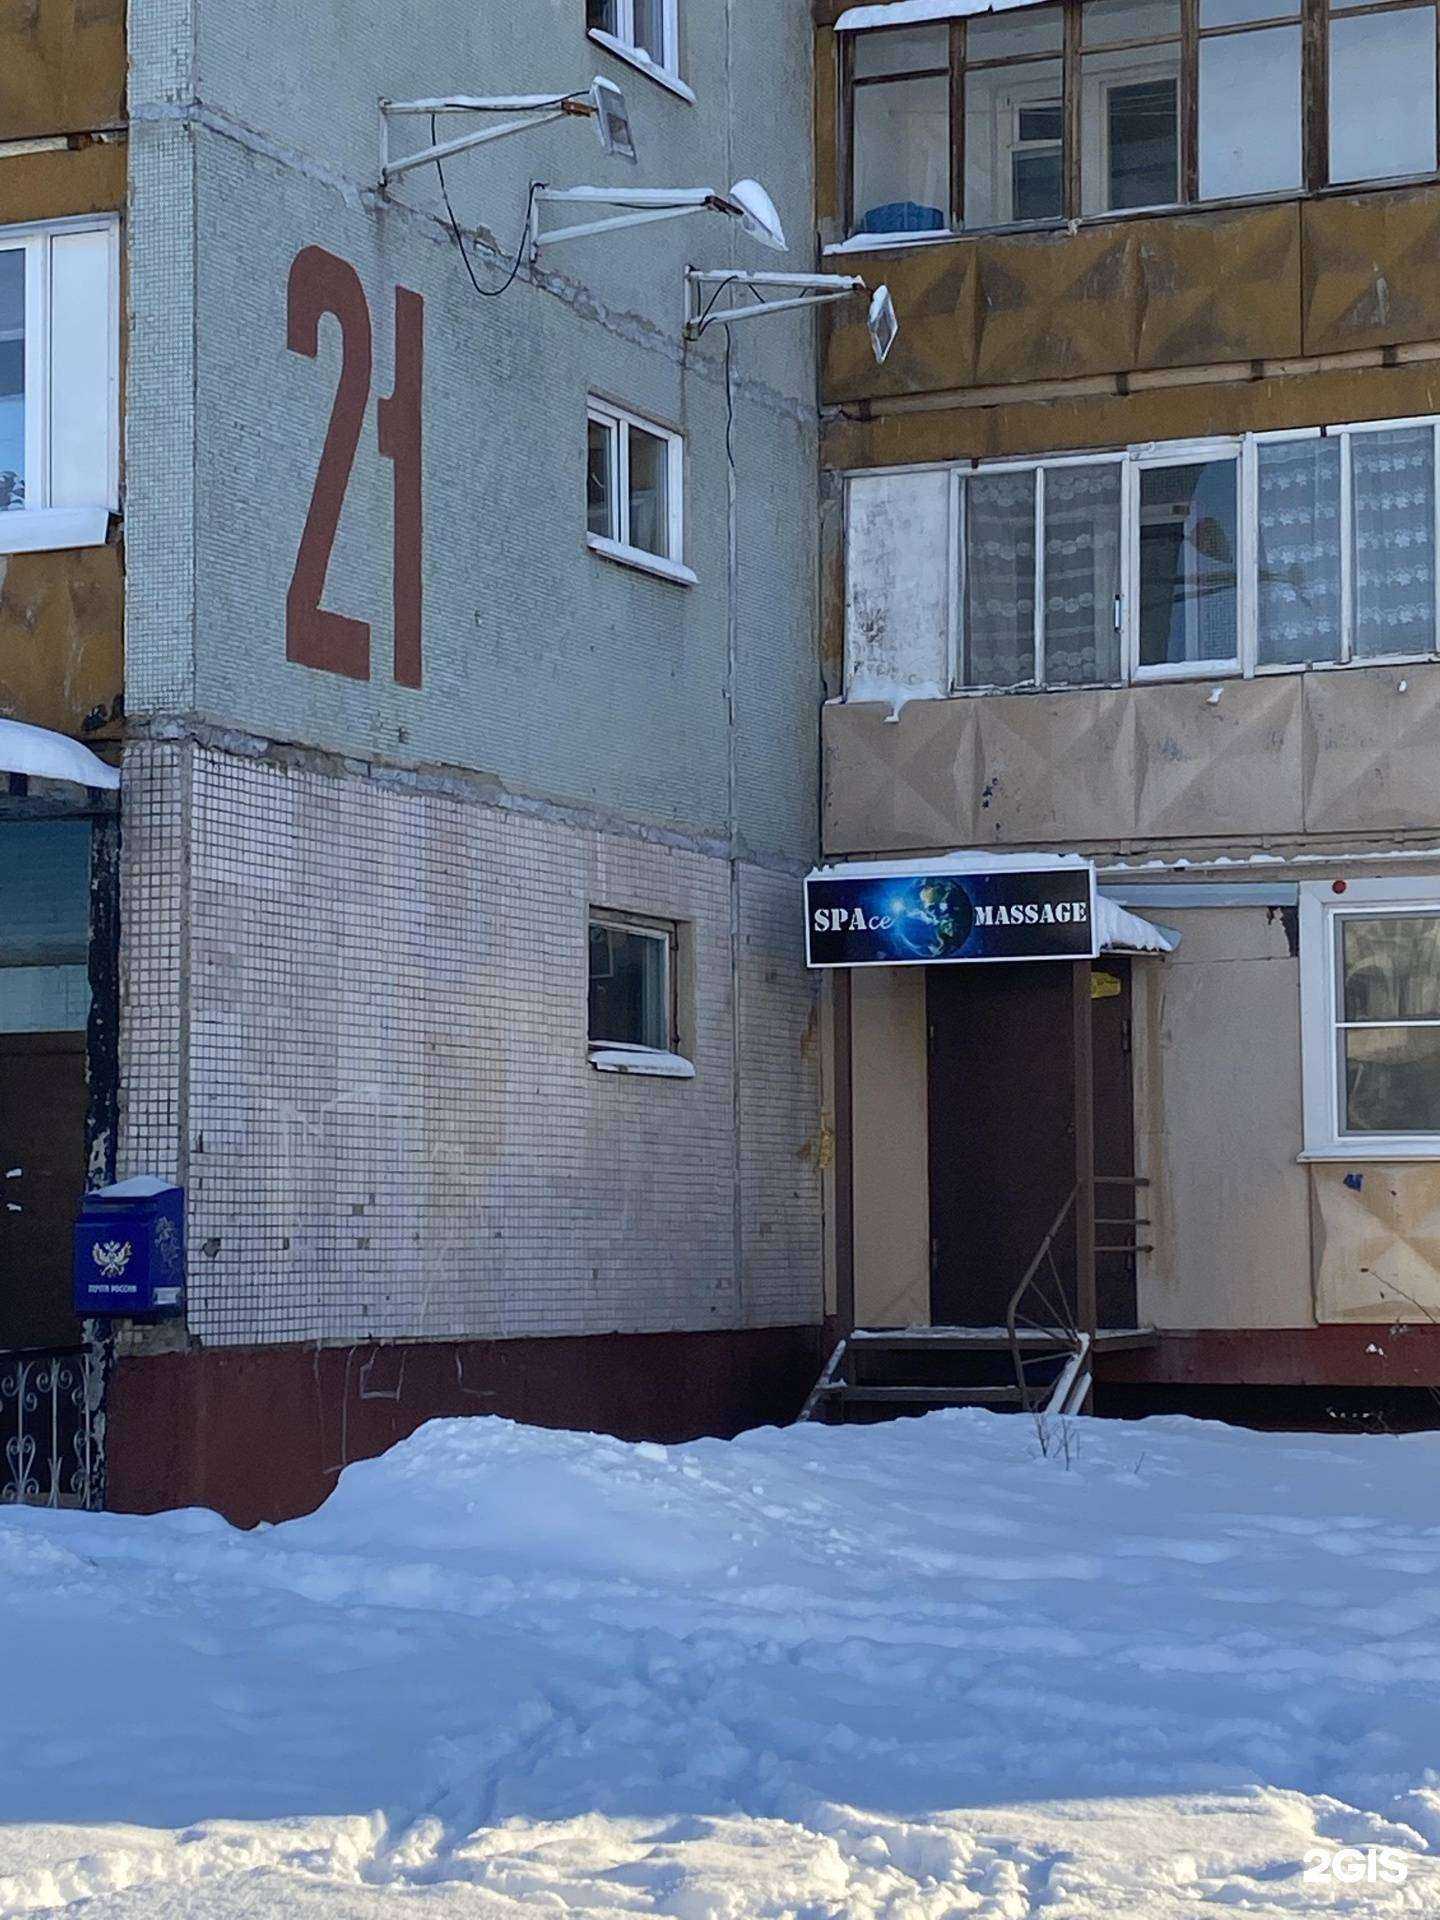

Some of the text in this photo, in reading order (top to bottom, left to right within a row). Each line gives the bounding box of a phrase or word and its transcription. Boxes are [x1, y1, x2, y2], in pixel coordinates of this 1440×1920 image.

[286, 245, 423, 689] 21
[814, 901, 1087, 932] SPAce MASSAGE
